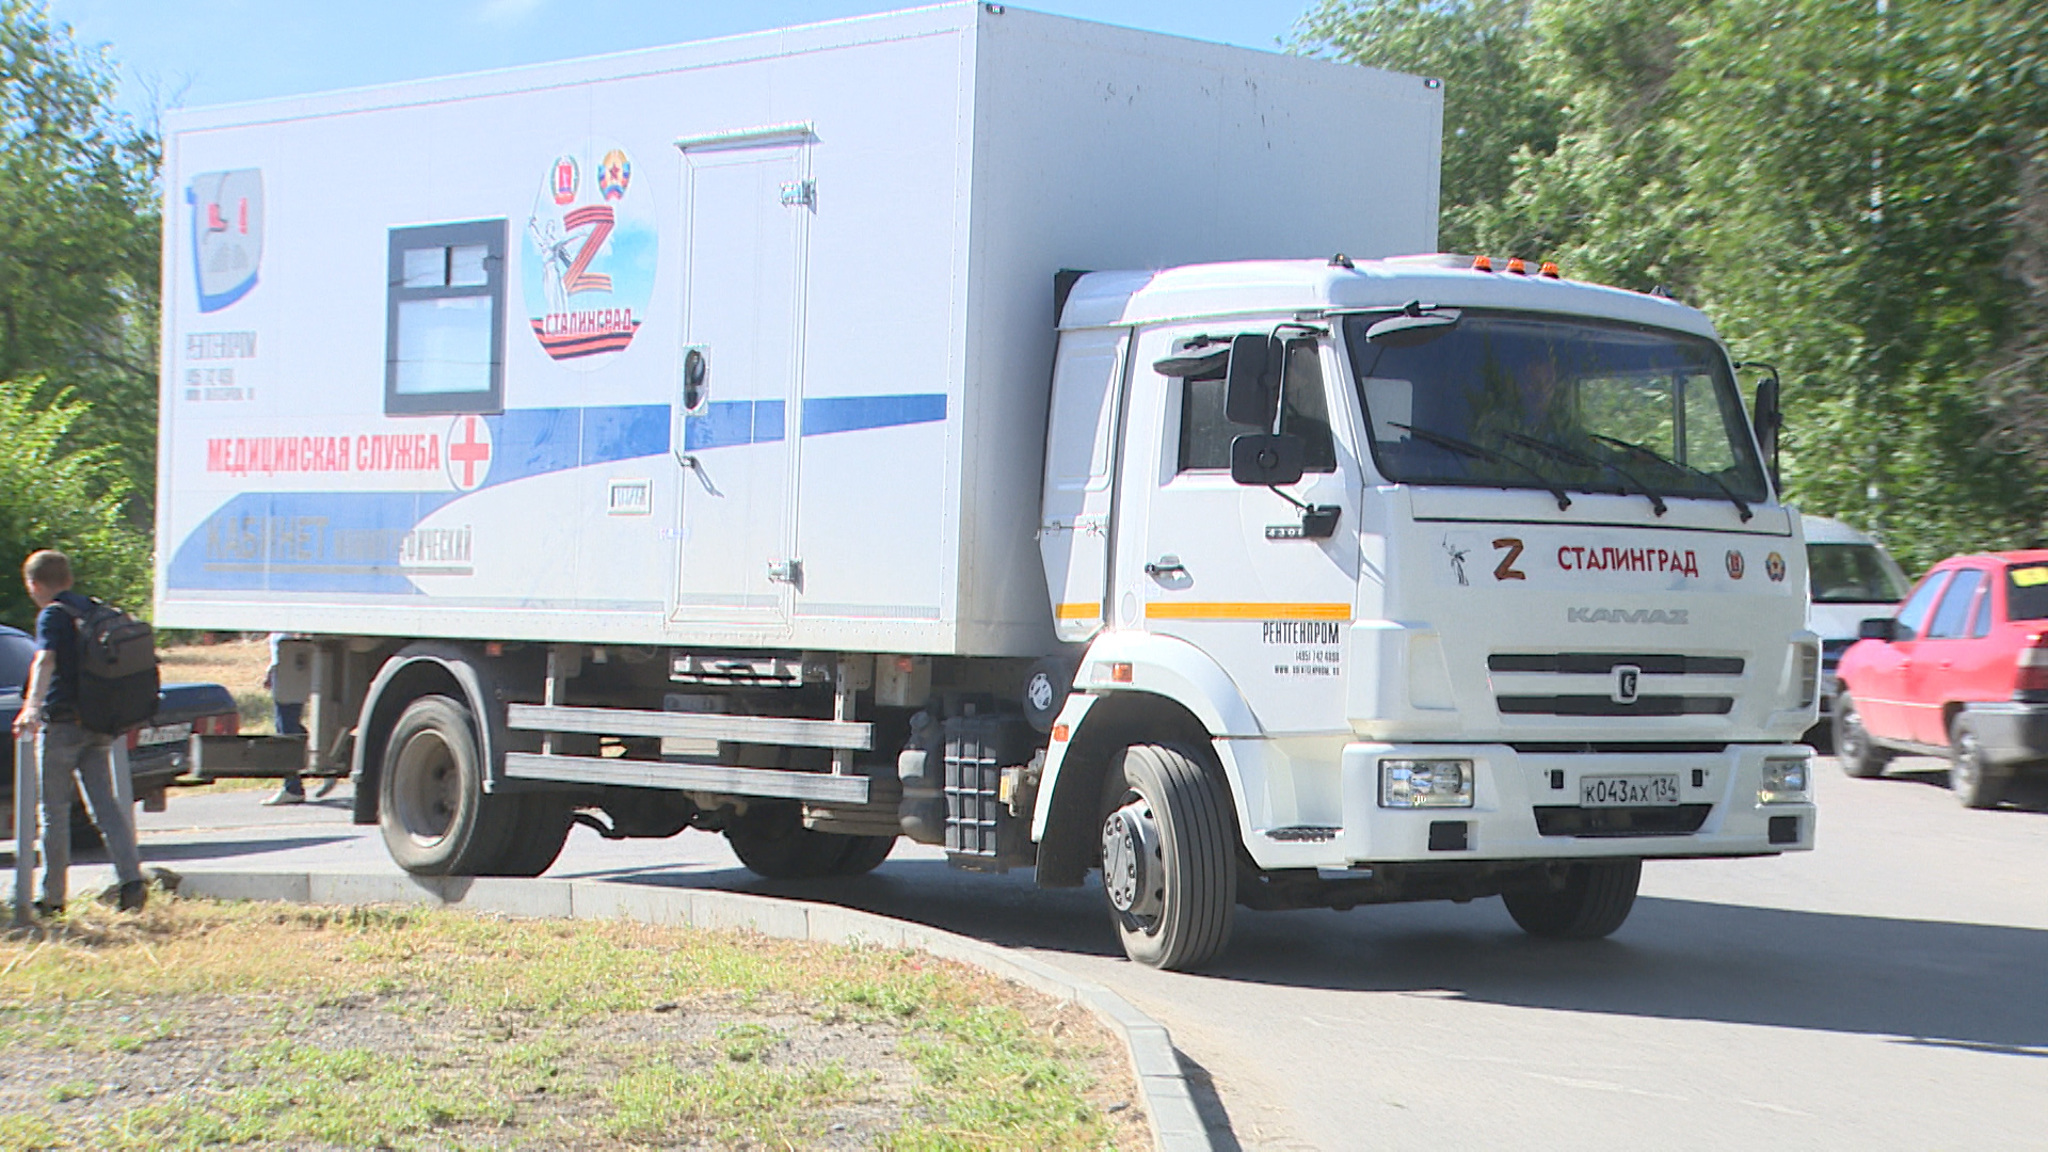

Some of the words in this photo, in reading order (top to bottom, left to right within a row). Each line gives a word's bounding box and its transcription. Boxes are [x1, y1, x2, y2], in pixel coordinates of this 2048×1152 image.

[546, 309, 632, 335] СТАЛИНГРАД
[207, 435, 350, 477] МЕДИЦИНСКАЯ
[356, 434, 440, 471] СЛУЖБА
[206, 516, 329, 559] КАБИНЕТ
[1557, 546, 1699, 577] СТАЛИНГРАД
[1567, 607, 1689, 625] KAMAZ
[1263, 621, 1340, 644] РЕНТГЕНПРОМ
[1652, 779, 1677, 796] 134
